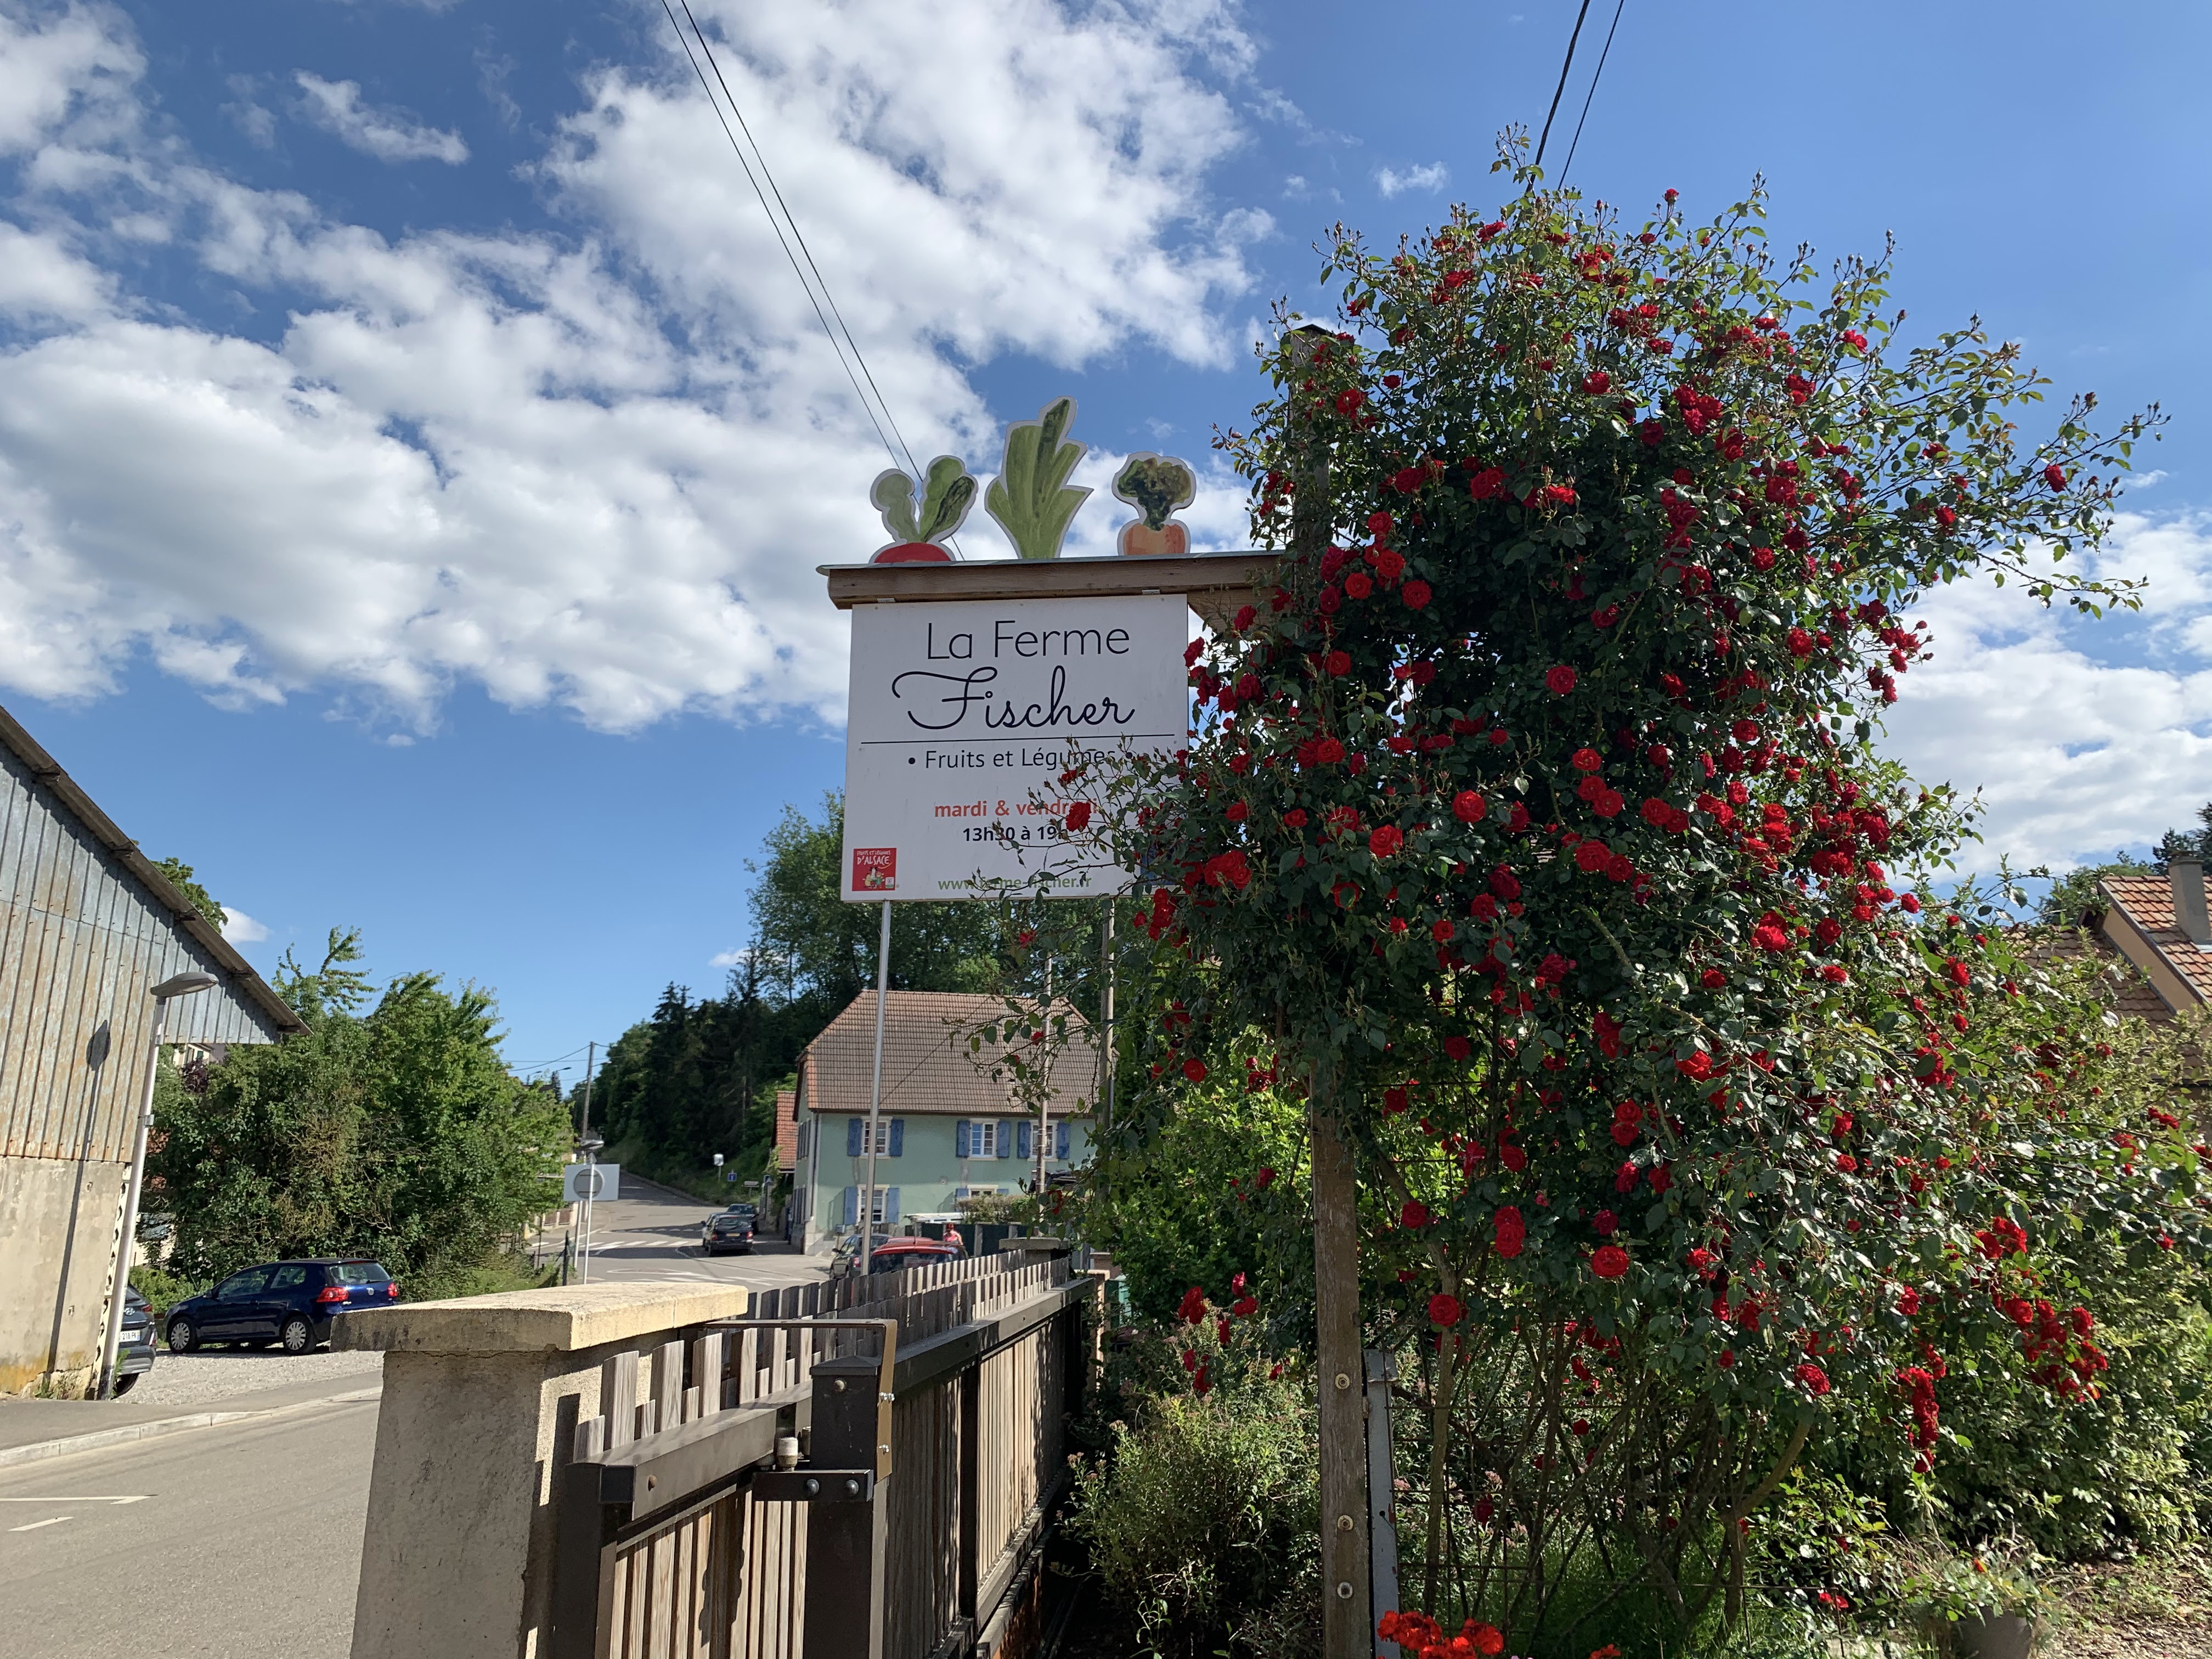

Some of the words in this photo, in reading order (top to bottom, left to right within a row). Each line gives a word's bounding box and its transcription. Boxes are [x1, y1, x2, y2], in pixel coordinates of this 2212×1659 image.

[928, 623, 973, 659] La
[995, 620, 1130, 657] Ferme
[892, 665, 1135, 730] Fischer
[926, 749, 985, 768] Fruits
[994, 751, 1014, 767] et
[935, 800, 986, 817] mardi
[995, 800, 1009, 816] &
[1016, 798, 1097, 815] vendri
[1021, 826, 1030, 840] à
[857, 855, 890, 866] D'ALSACE
